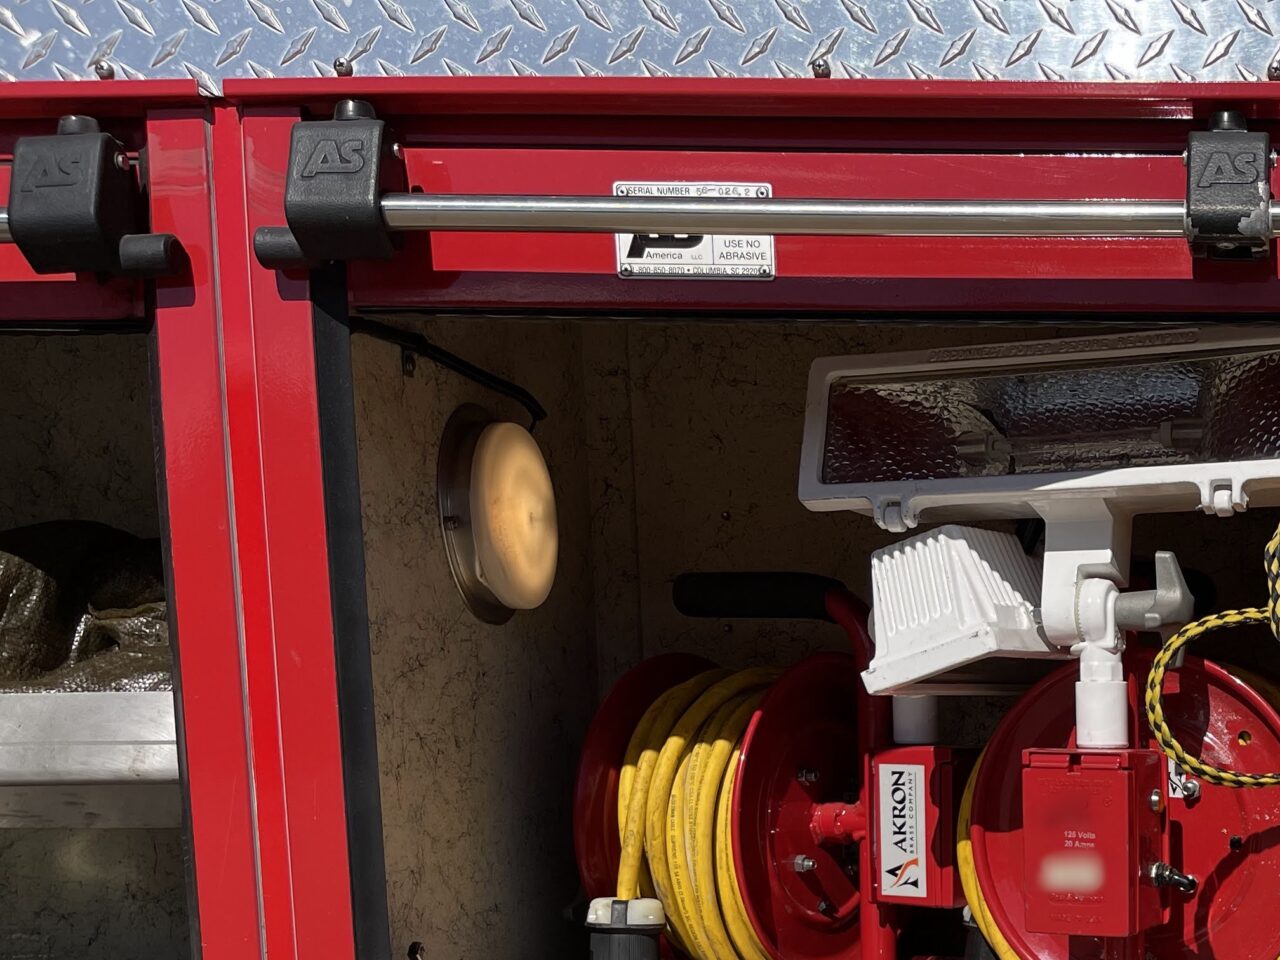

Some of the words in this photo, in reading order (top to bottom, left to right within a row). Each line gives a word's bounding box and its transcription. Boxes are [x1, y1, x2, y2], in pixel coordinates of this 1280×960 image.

[301, 139, 366, 178] AS
[1197, 152, 1260, 188] AS
[627, 186, 653, 195] SERIAL
[656, 187, 690, 196] NUMBER
[724, 240, 744, 249] USE
[746, 240, 761, 249] NO
[645, 251, 683, 260] America
[718, 252, 767, 261] ABRASIVE
[730, 267, 740, 275] SC
[929, 345, 1005, 362] DISCONNECT
[1010, 342, 1052, 357] POWER
[1058, 338, 1110, 353] BEFORE
[891, 770, 907, 853] AKRON
